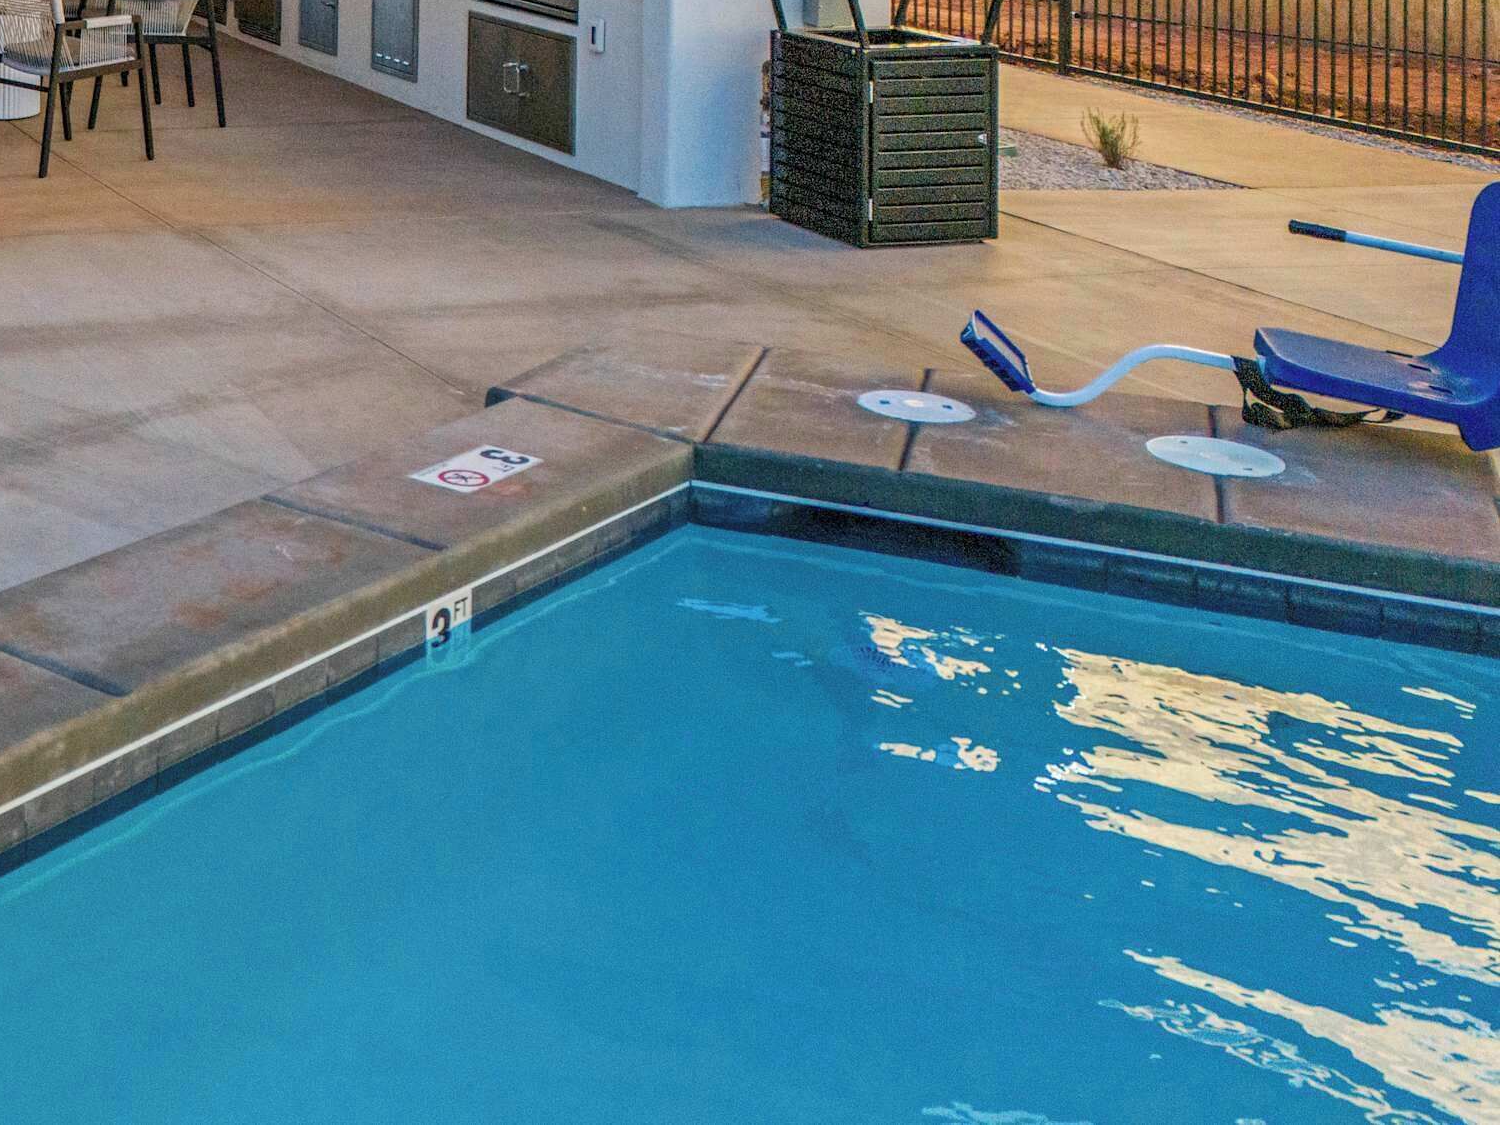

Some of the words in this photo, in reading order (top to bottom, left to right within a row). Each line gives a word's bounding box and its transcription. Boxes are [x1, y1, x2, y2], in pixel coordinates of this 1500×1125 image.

[479, 449, 530, 465] 3
[431, 607, 452, 648] 3
[453, 596, 468, 621] FT
